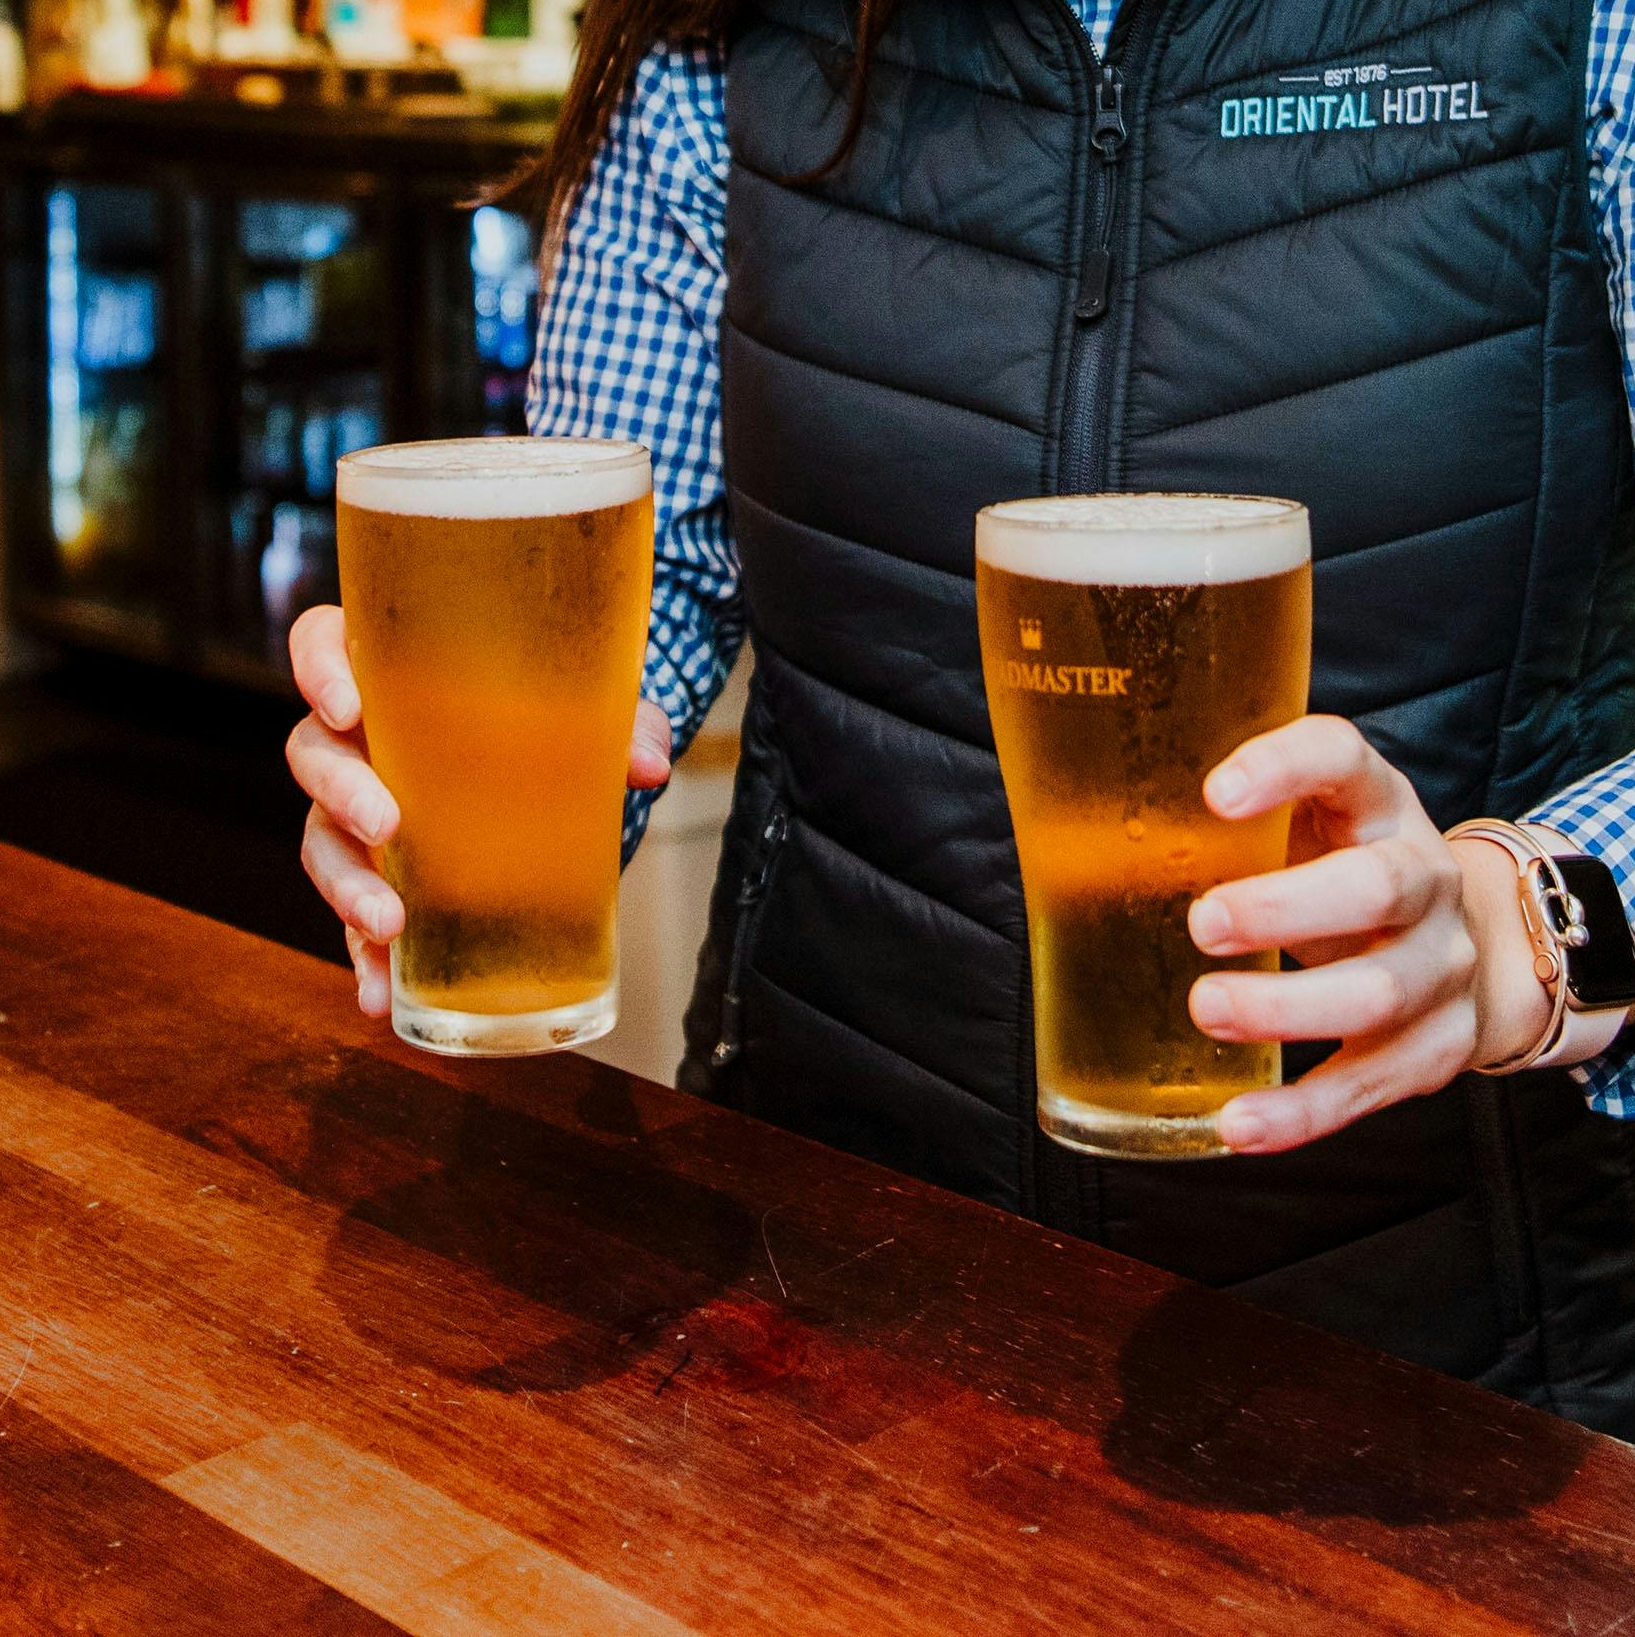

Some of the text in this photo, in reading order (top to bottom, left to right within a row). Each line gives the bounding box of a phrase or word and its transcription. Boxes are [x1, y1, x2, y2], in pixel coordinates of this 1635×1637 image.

[1324, 66, 1352, 88] EST
[1221, 81, 1489, 139] ORIENTAL HOTEL
[1005, 661, 1130, 695] DMASTER
